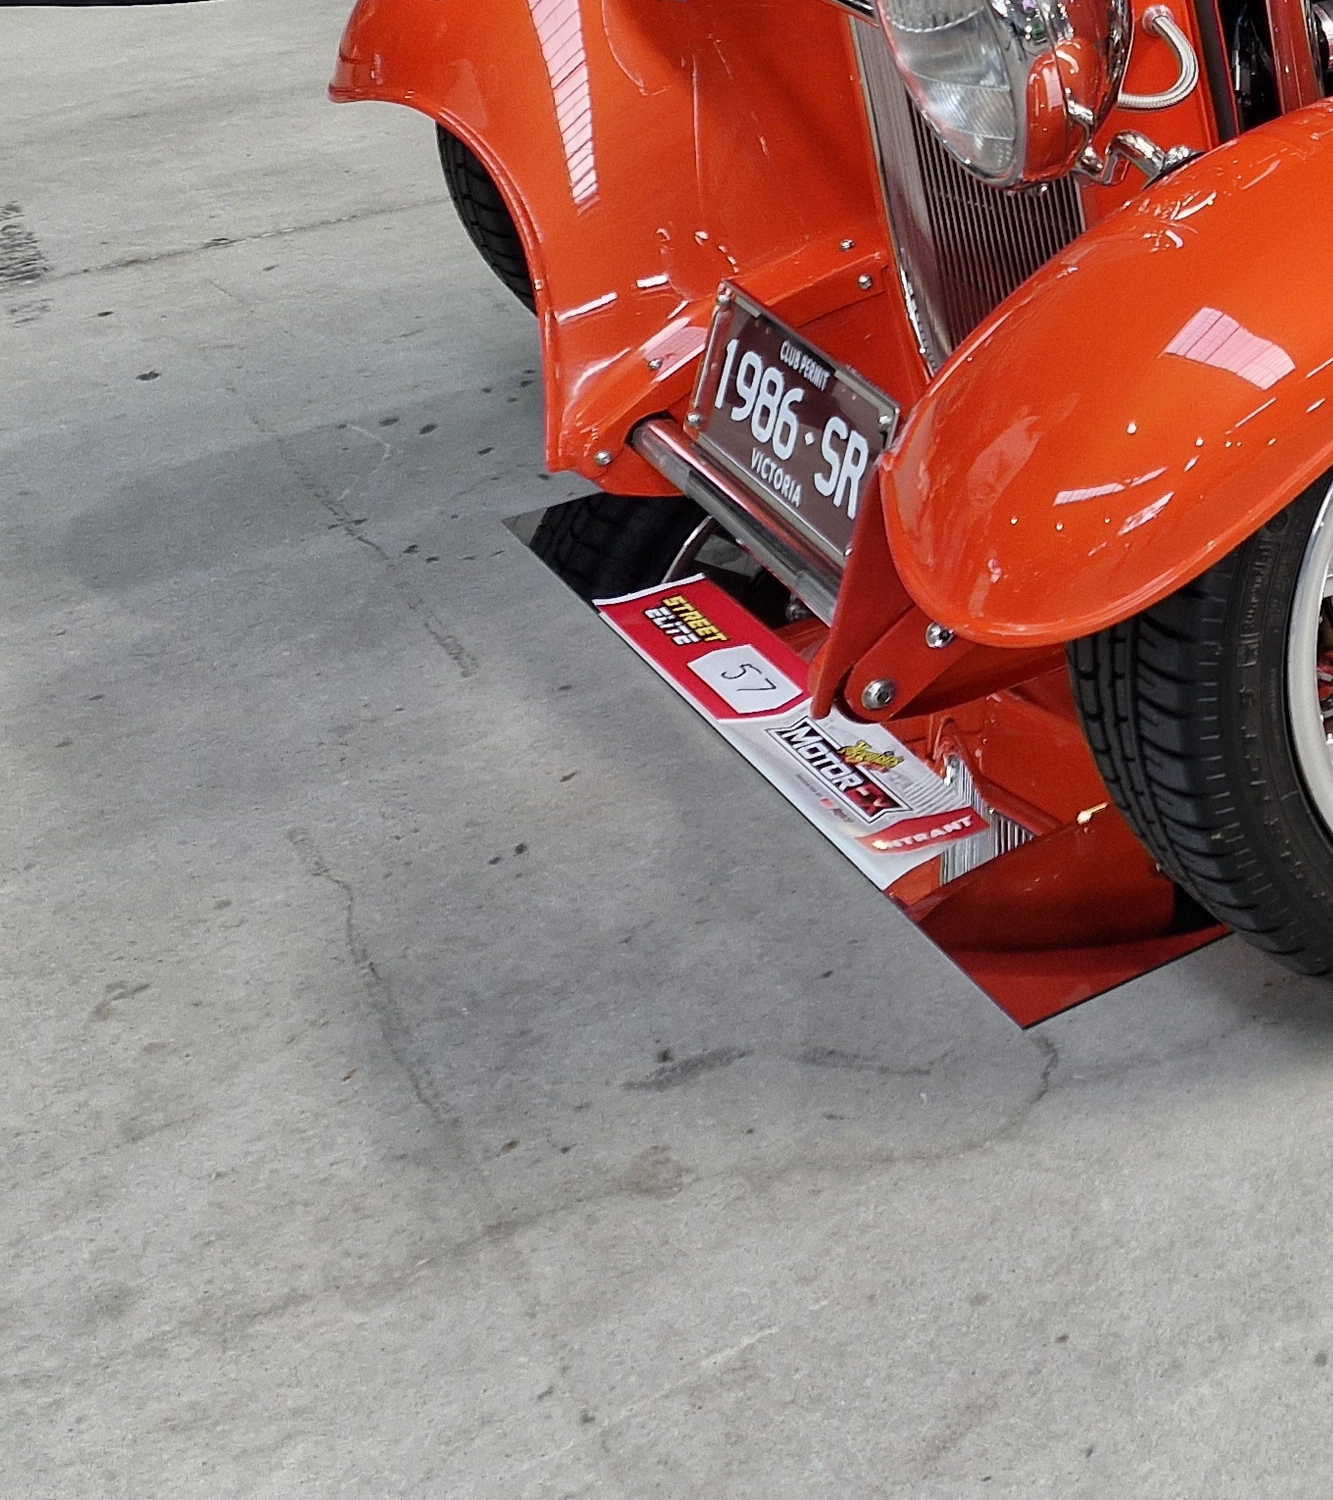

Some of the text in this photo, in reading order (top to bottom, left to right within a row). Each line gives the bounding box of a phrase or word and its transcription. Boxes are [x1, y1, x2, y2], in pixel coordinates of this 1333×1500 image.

[779, 340, 831, 392] CLUB PERMIT
[751, 447, 803, 508] VICTORIA
[644, 606, 701, 646] ELITE
[662, 594, 729, 642] STREET
[720, 663, 777, 692] 57
[871, 814, 973, 851] NTRANT
